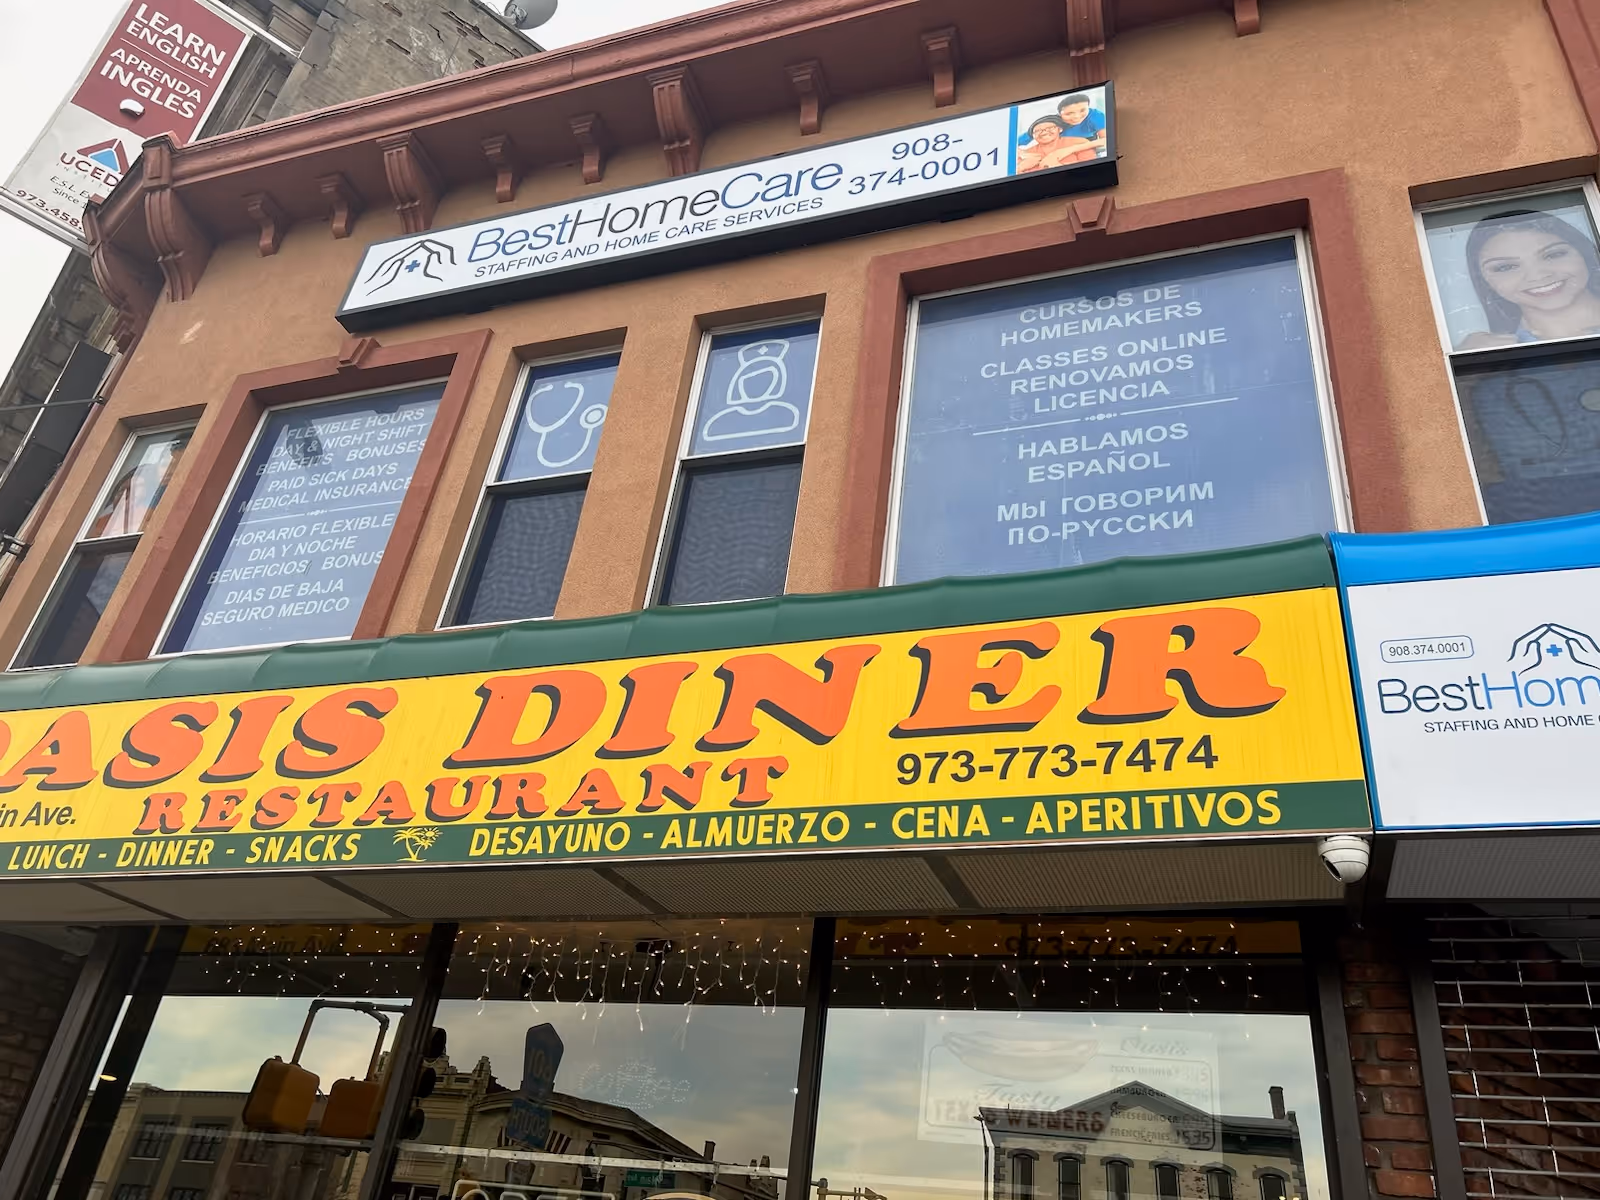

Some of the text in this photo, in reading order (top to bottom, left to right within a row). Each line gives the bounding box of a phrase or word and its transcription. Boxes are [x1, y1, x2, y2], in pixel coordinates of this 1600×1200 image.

[126, 20, 217, 79] ENGLISH
[135, 2, 226, 66] LEARN
[100, 60, 197, 119] INGLES
[110, 48, 202, 103] APRENDA
[891, 132, 963, 160] 908-
[60, 152, 120, 187] UCED
[847, 147, 999, 196] 374-0001
[52, 187, 80, 204] Since
[467, 162, 843, 263] BestHomeCare
[474, 197, 823, 278] STAFFING AND HOME CARE SERVICES
[1019, 284, 1182, 324] CURSOS DE
[1000, 300, 1203, 347] HOMEMAKERS
[980, 327, 1228, 380] CLASSES ONLINE
[1010, 354, 1194, 395] RENOVAMOS
[1034, 380, 1170, 413] LICENCIA
[287, 408, 425, 439] FLEXIBLE HOURS
[1017, 422, 1189, 460] HABLAMOS
[272, 442, 305, 458] DAY
[307, 440, 318, 452] &
[322, 431, 377, 450] NIGHT
[256, 452, 334, 476] BENEFITS
[267, 462, 399, 492] PAID SICK DAYS
[1027, 450, 1171, 484] ESPAÑOL
[238, 492, 310, 513] MEDICAL
[229, 513, 395, 547] HORARIO FLEXIBLE
[247, 535, 359, 562] DIA Y NOCHE
[207, 560, 309, 584] BENEFICIOS
[224, 578, 344, 605] DIAS DE BAJA
[201, 597, 350, 626] SEGURO MEDICO
[1389, 641, 1466, 657] 908.374.0001
[0, 607, 1287, 794] ASIS DINER
[1423, 715, 1595, 734] STAFFING AND HOME
[896, 733, 1219, 786] 973-773-7474
[132, 755, 790, 836] RESTAURANT
[20, 801, 76, 827] Ave.
[468, 820, 631, 858] DESAYUNO
[660, 810, 851, 850] ALMUERZO
[891, 804, 991, 840] CENA
[1025, 789, 1283, 836] APERITIVOS
[7, 844, 91, 870] LUNCH
[115, 838, 215, 868] DINNER
[245, 833, 362, 865] SNACKS
